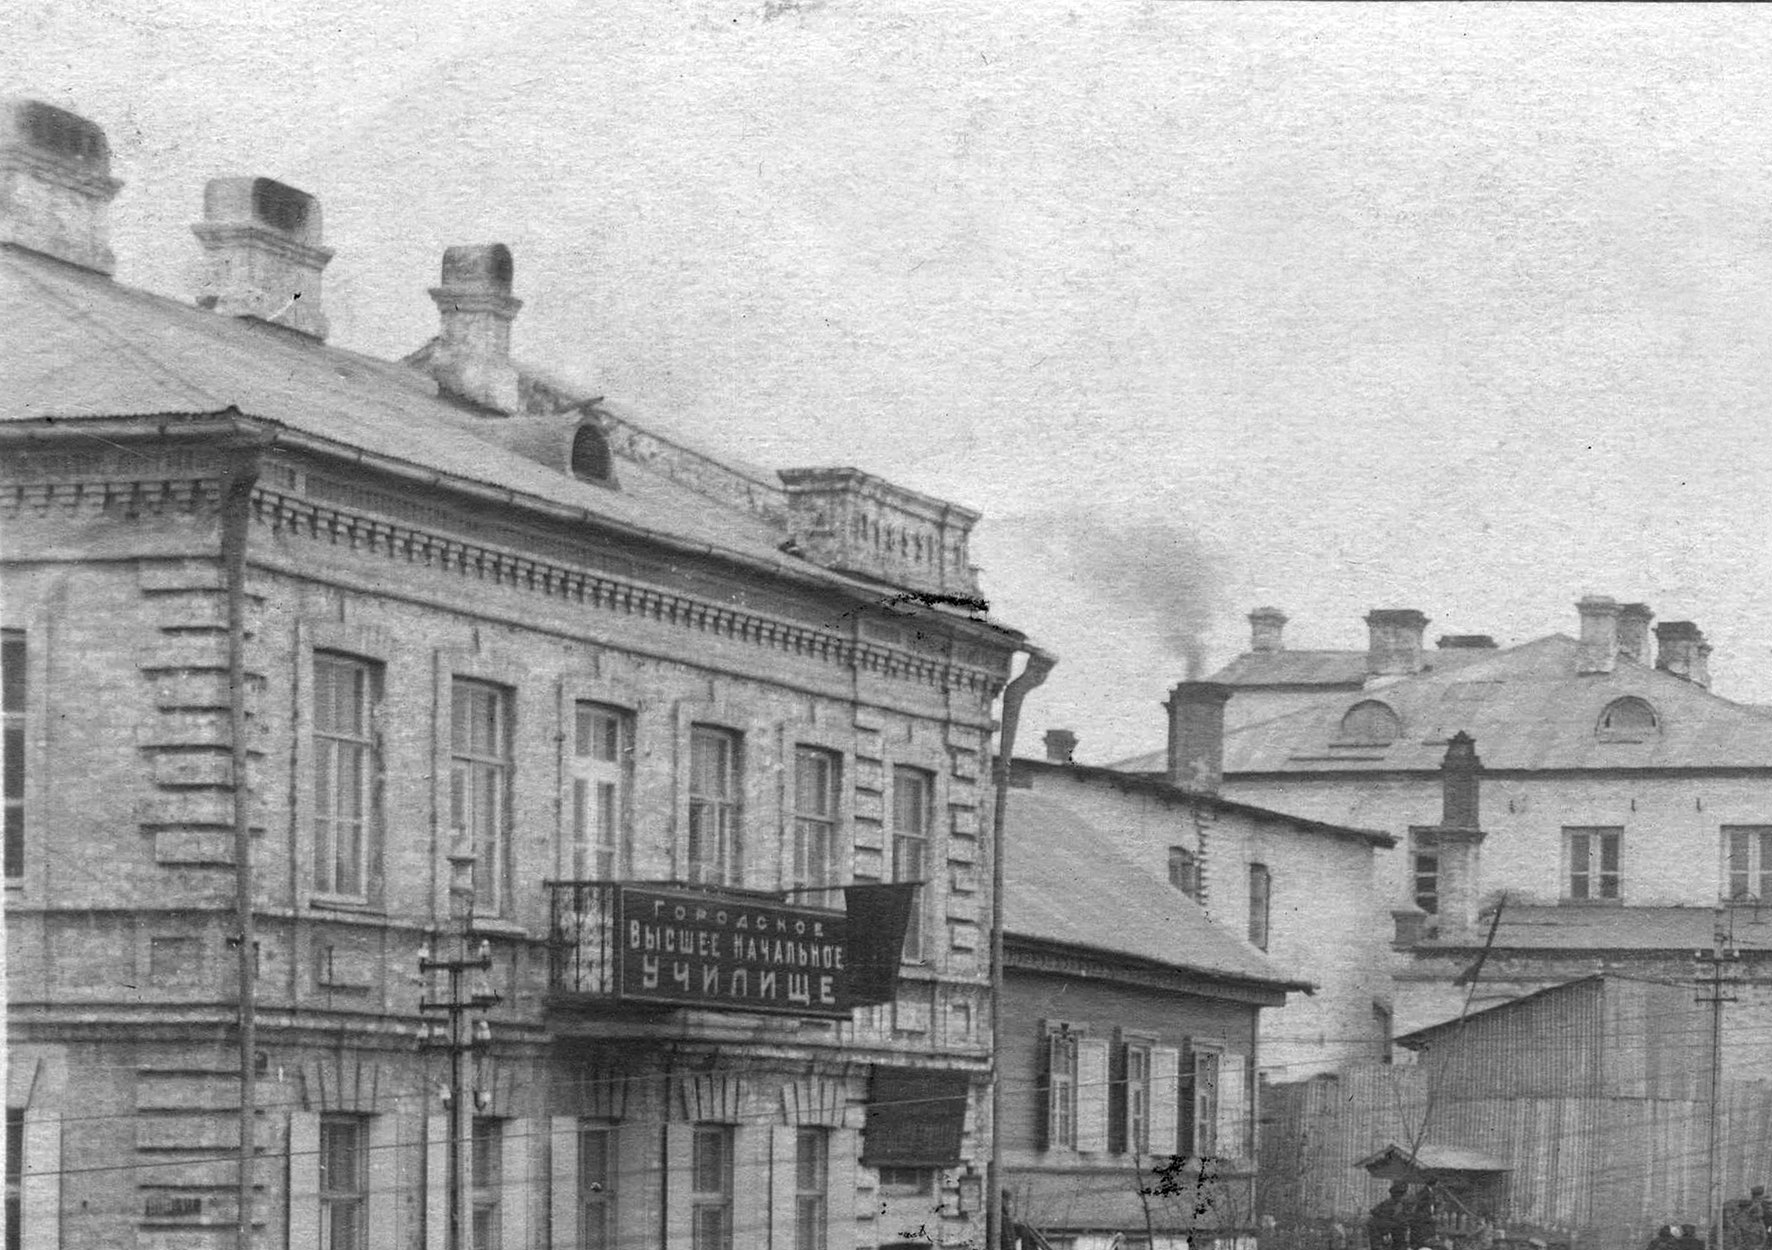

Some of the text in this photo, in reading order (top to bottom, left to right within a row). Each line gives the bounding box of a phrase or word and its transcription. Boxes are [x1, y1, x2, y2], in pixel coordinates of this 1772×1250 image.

[654, 900, 824, 937] ГОРОДСКОЕ
[630, 919, 845, 970] ВЫСШЕЕ НАЧАЛЬНОЕ
[643, 954, 836, 1006] УЧИЛИЩЕ
